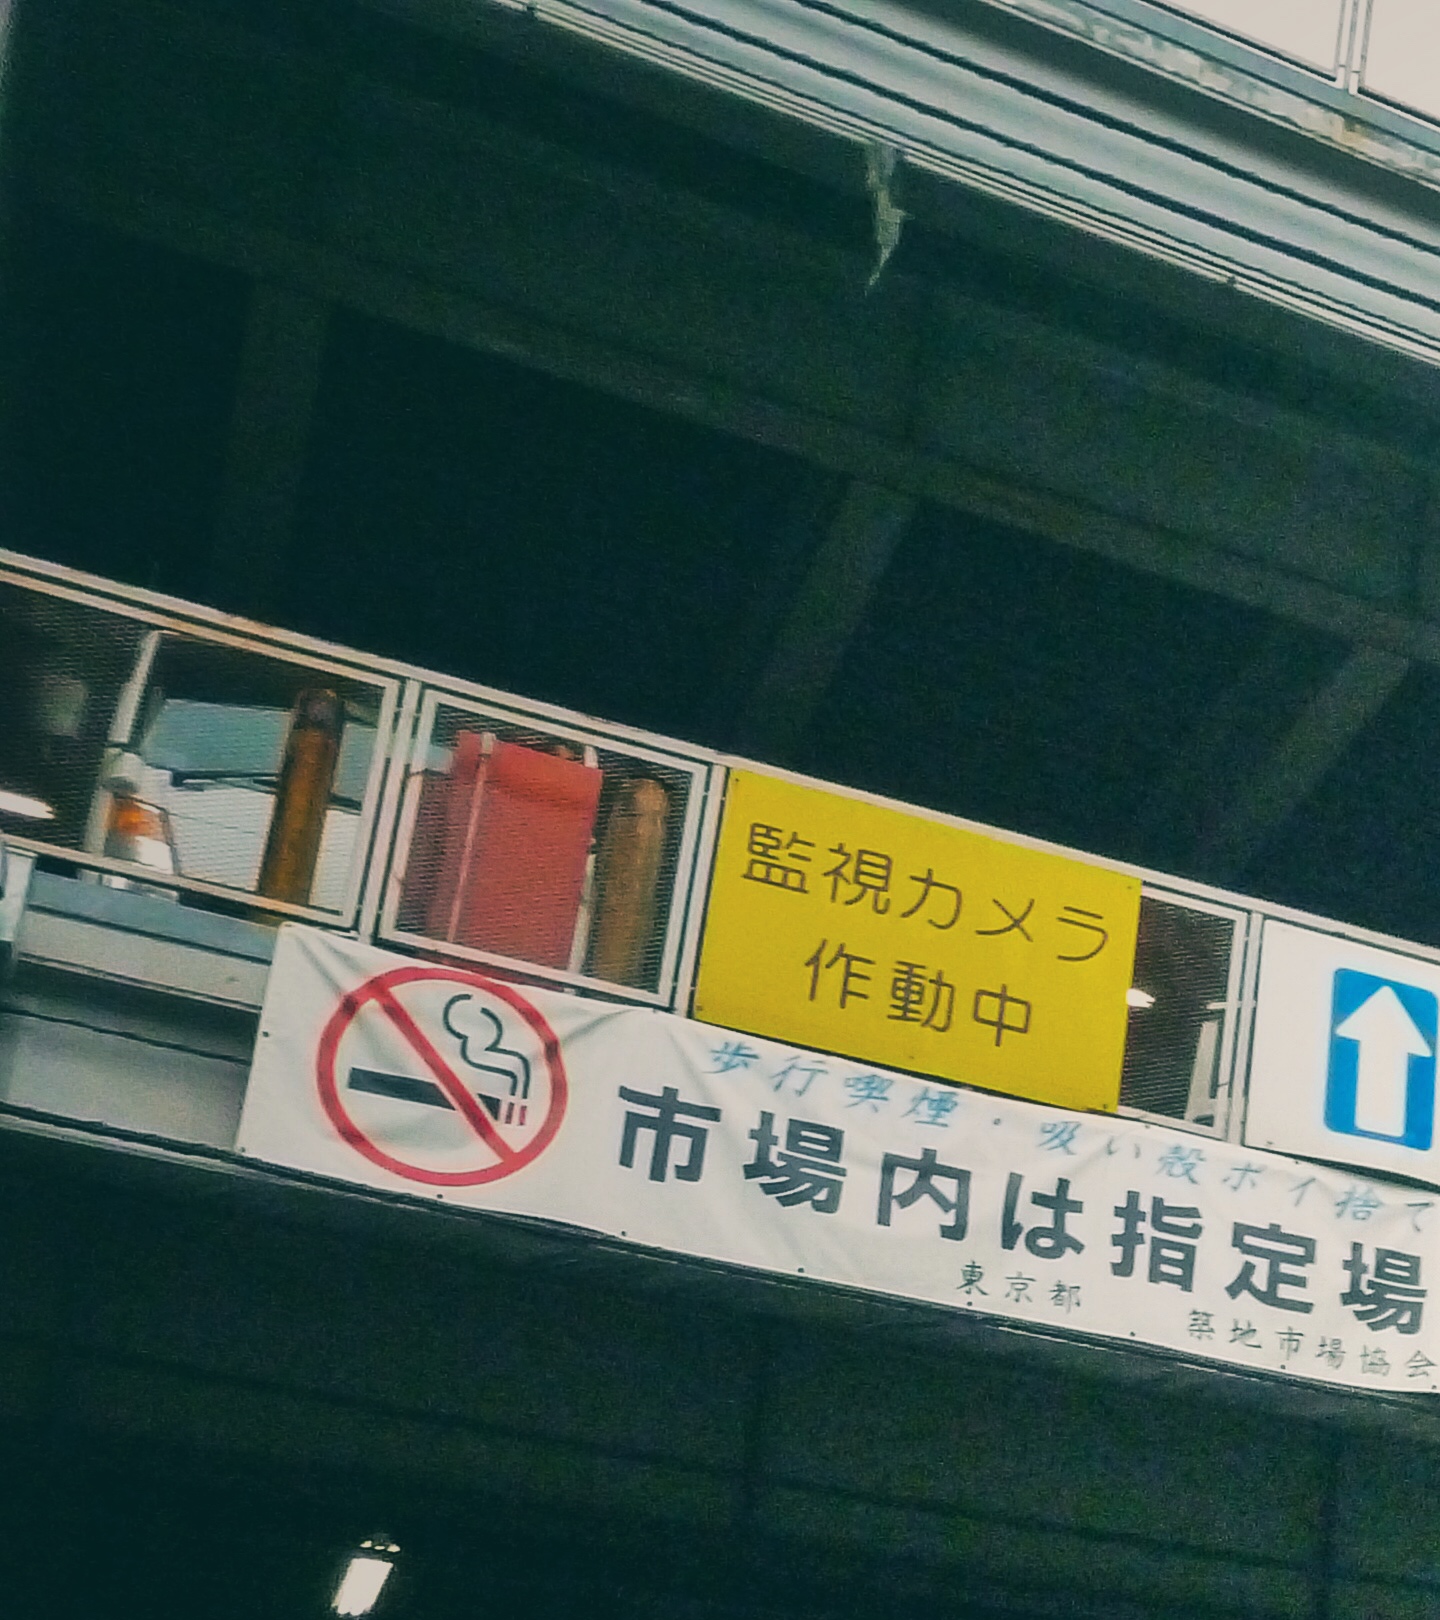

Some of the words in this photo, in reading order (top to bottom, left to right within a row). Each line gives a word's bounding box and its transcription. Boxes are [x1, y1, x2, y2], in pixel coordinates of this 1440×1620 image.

[742, 823, 1109, 962] 監視カメラ
[804, 939, 1032, 1047] 作動中
[956, 1260, 1081, 1310] 東京都
[1186, 1309, 1437, 1379] 築地市場協会
